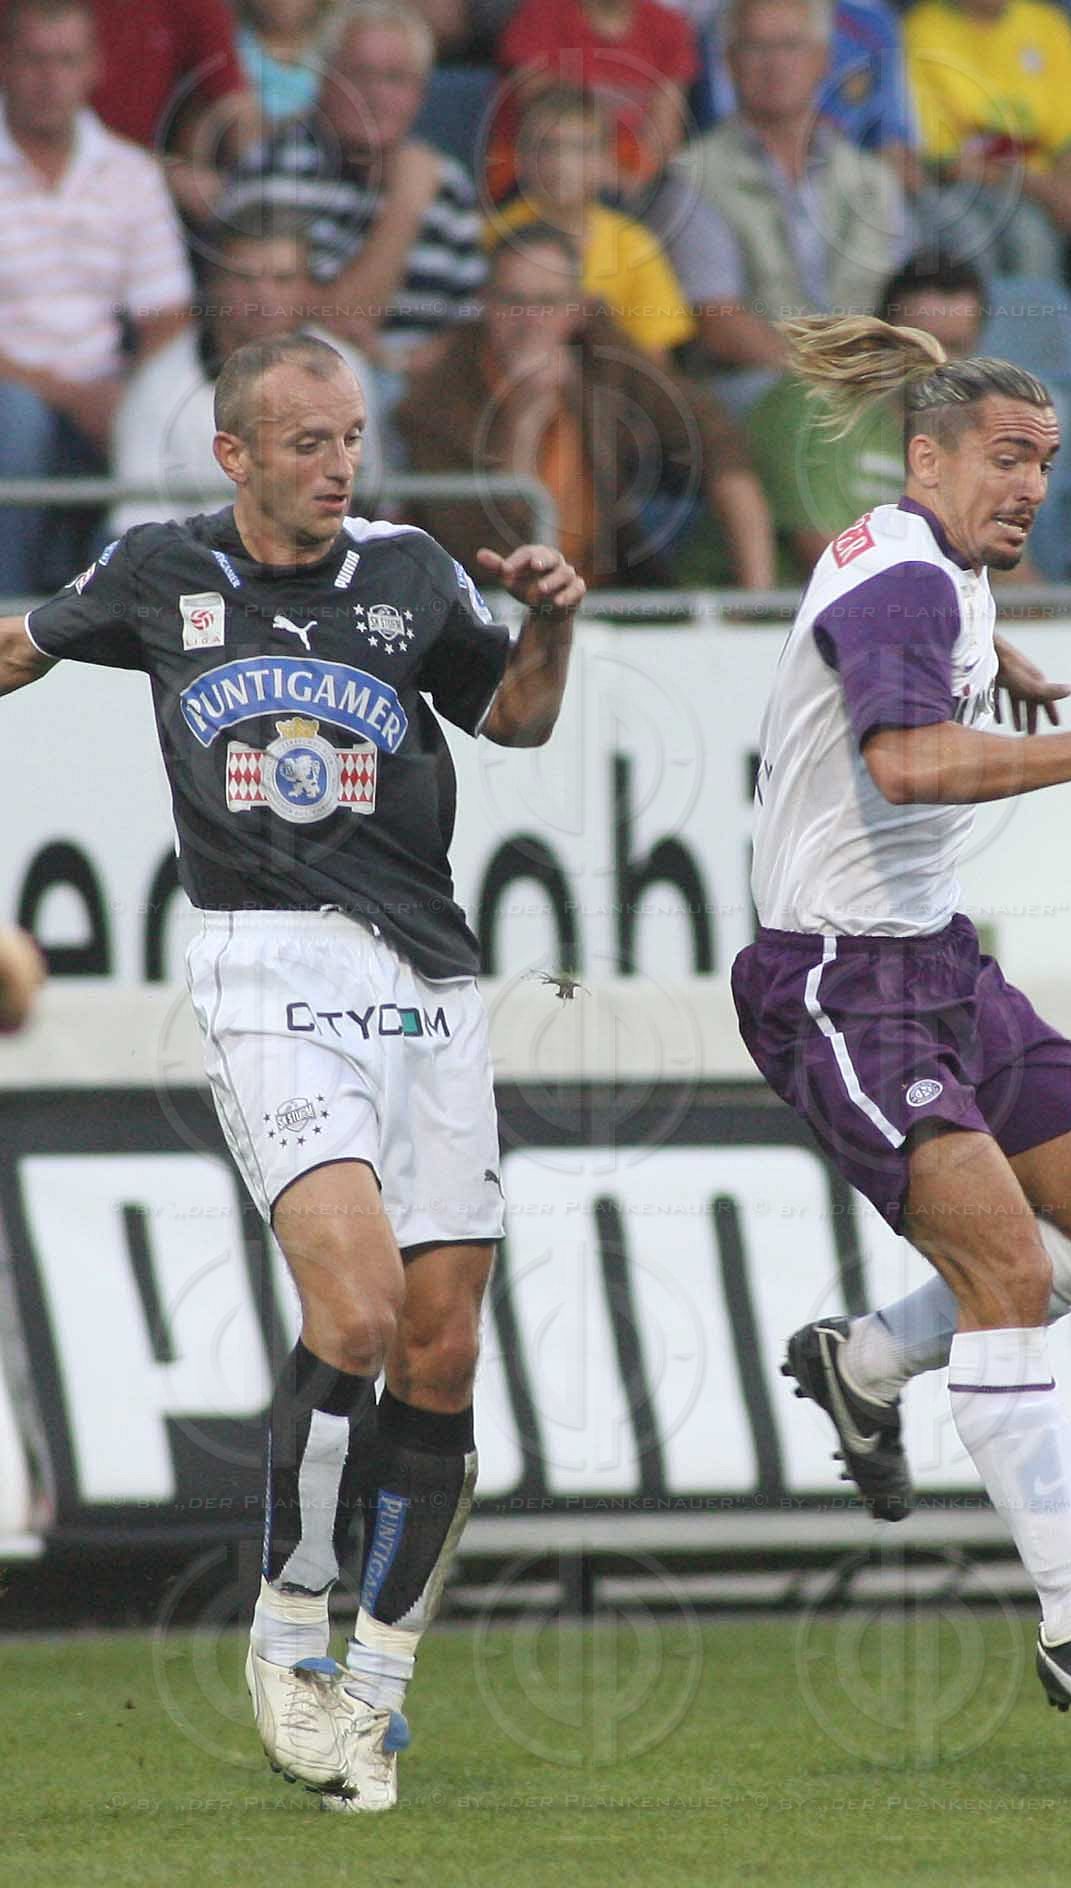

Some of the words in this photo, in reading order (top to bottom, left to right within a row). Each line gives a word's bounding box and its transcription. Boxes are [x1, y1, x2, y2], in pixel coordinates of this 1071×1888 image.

[334, 550, 360, 589] PUMA
[185, 636, 221, 648] LIGA
[185, 667, 400, 748] PUNTIGAMER
